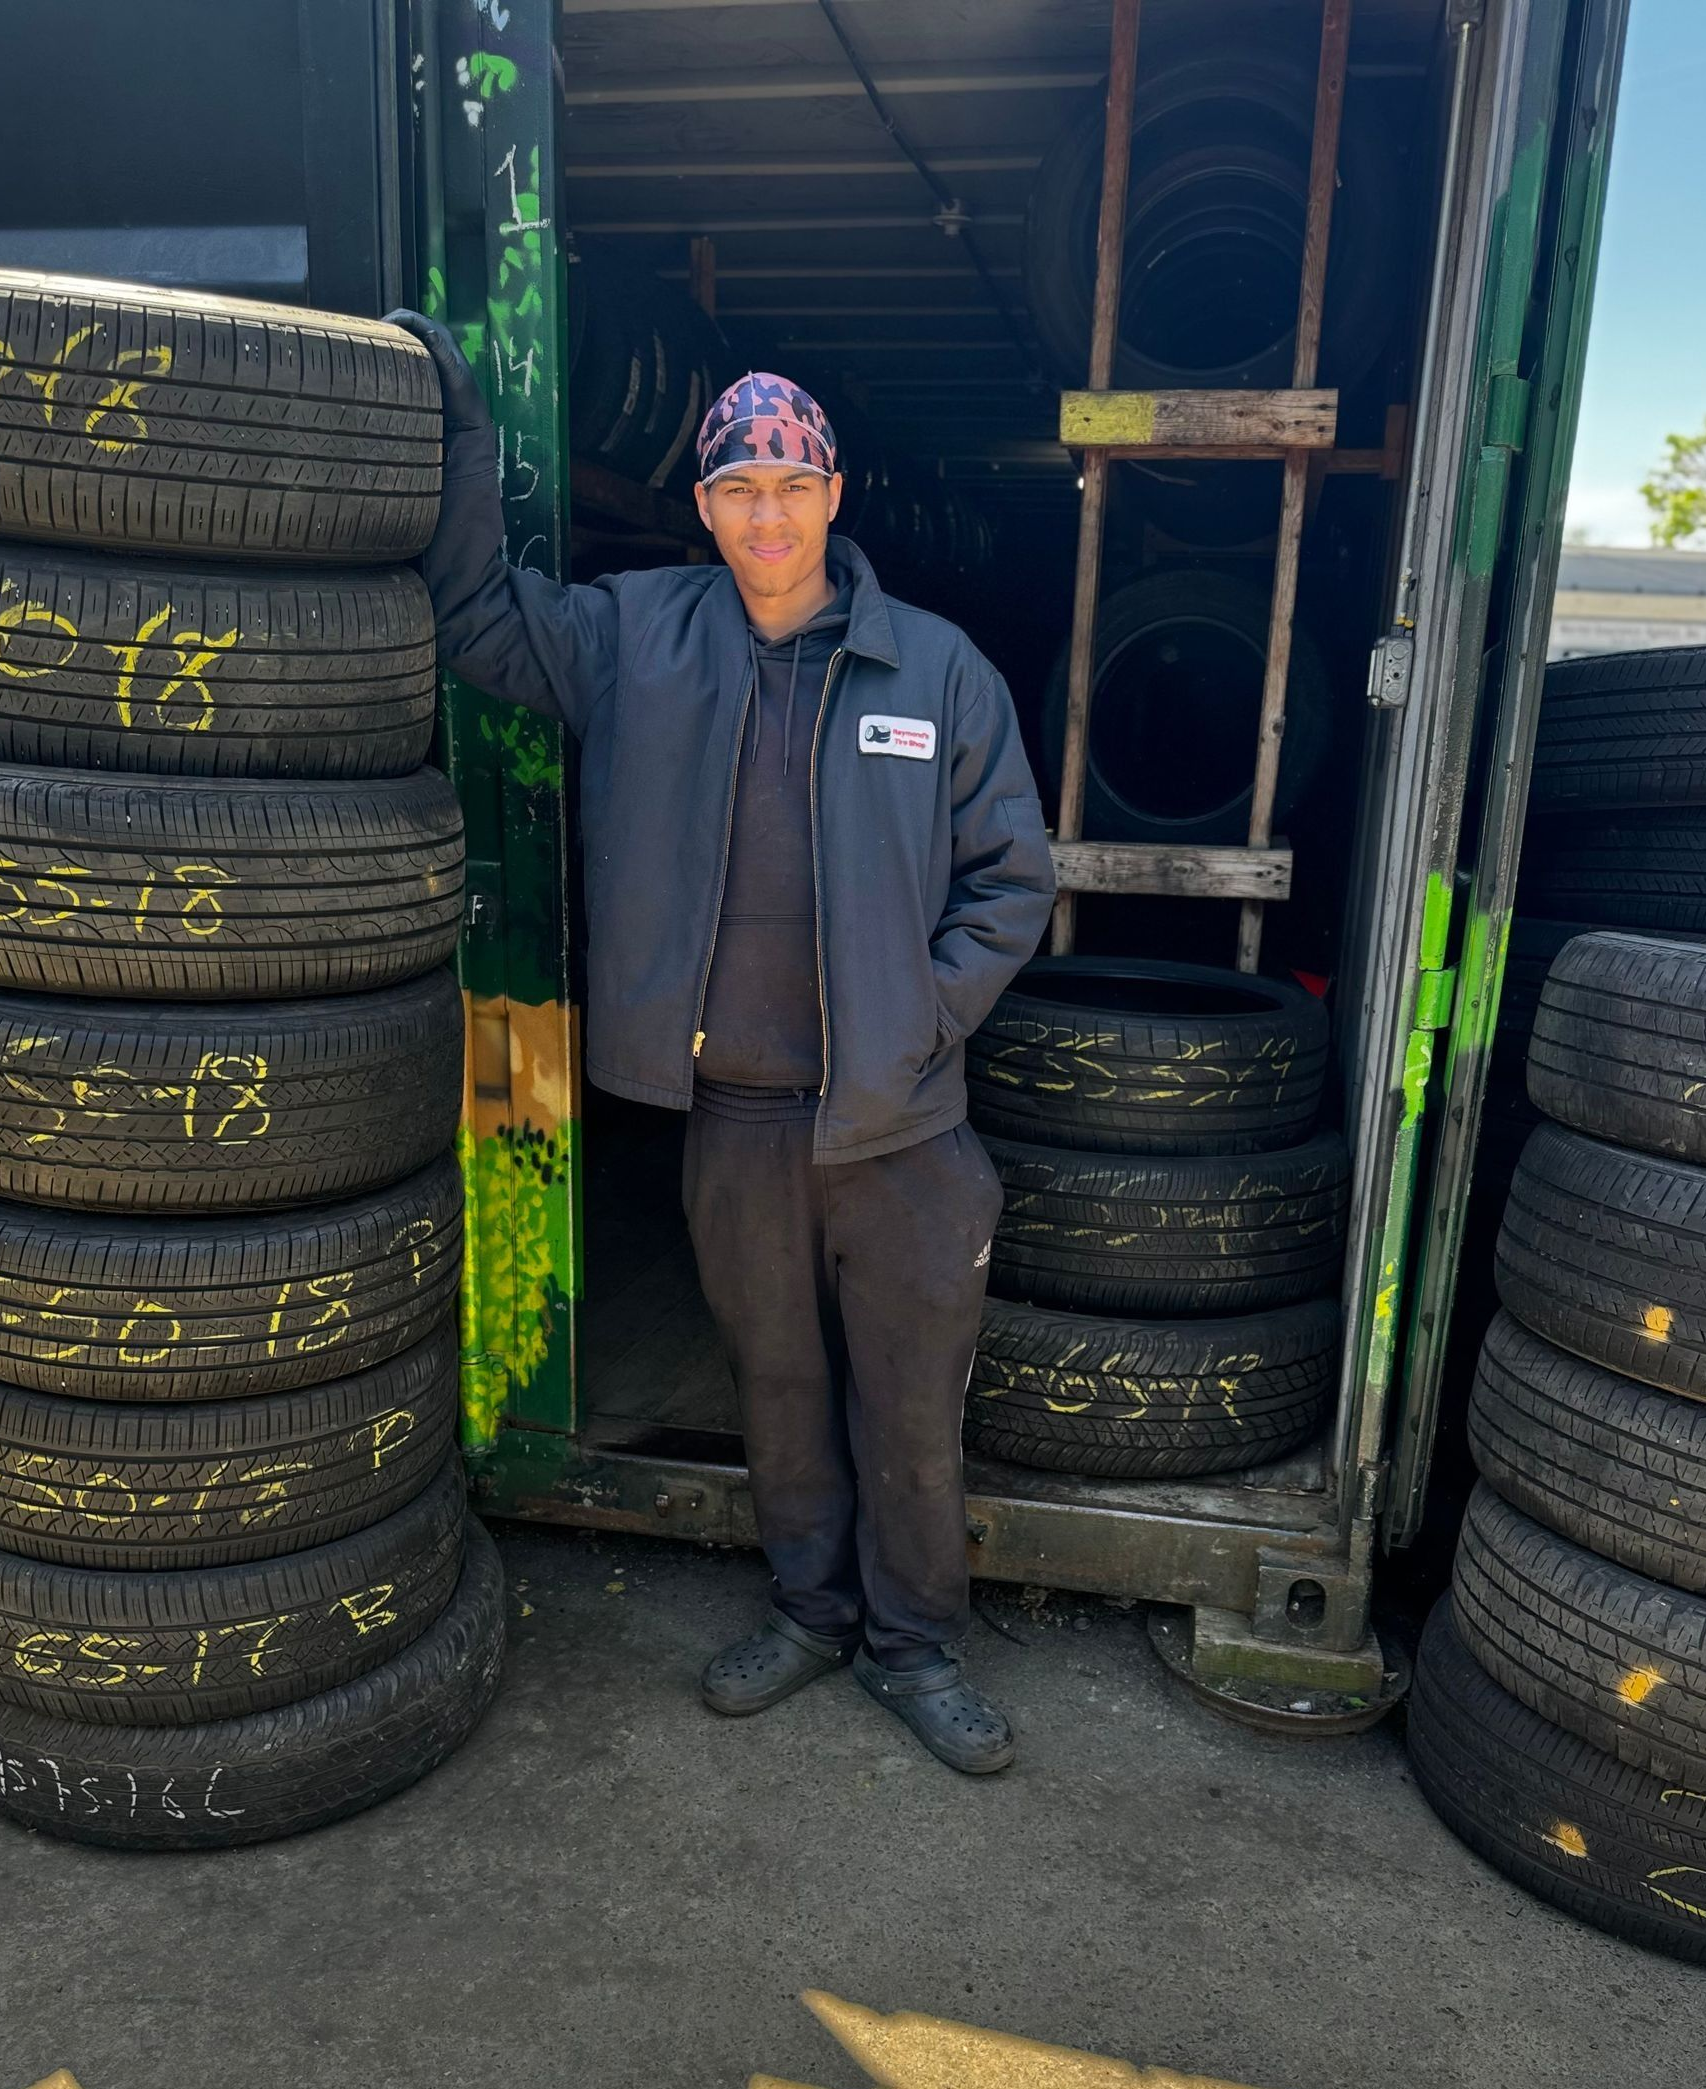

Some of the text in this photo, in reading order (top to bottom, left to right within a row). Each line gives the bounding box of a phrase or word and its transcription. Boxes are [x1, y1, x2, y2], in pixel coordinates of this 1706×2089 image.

[491, 336, 533, 397] 14
[497, 424, 540, 501] 15
[909, 740, 926, 749] Shop
